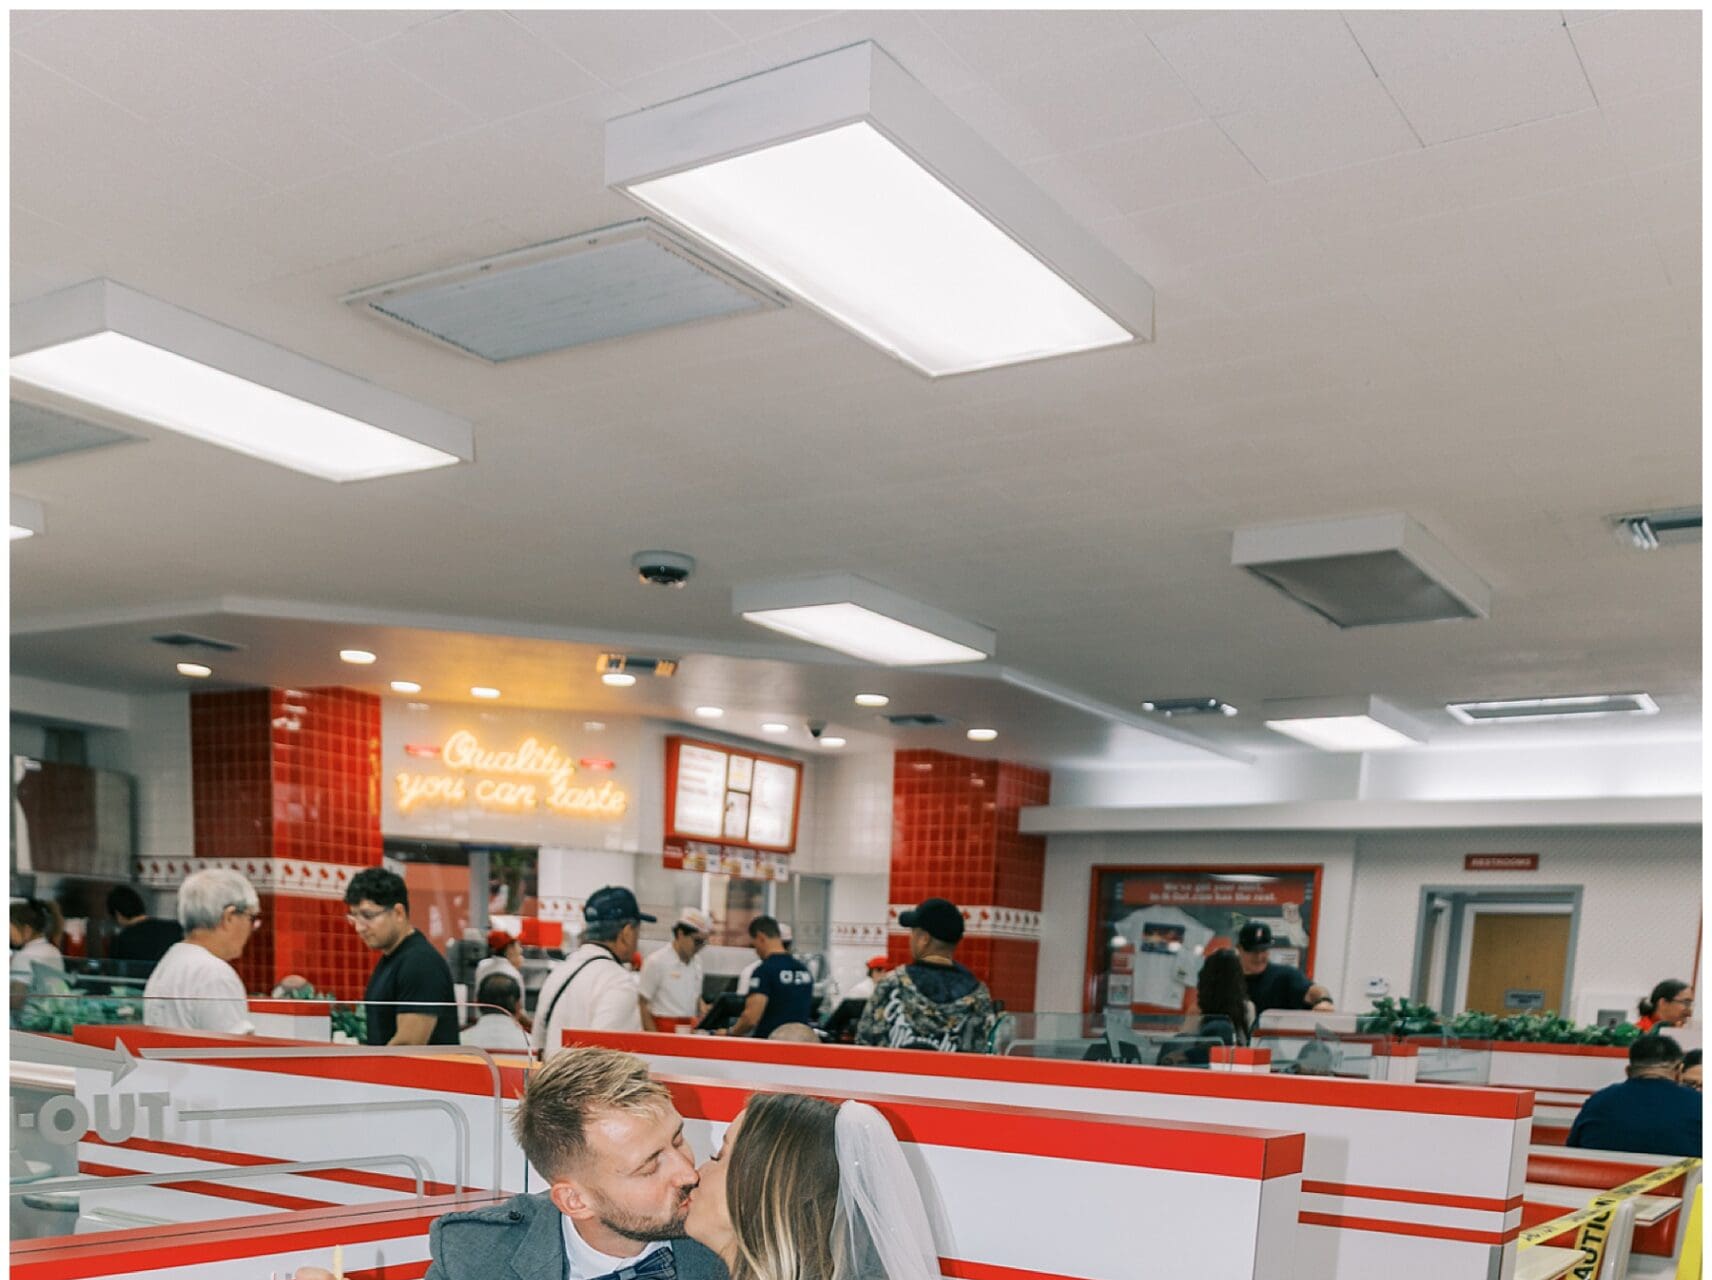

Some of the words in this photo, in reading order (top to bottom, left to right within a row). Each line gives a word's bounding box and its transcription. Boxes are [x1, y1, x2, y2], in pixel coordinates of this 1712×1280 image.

[443, 730, 576, 783] Quality
[396, 772, 466, 809] you
[475, 778, 537, 807] can
[546, 777, 627, 811] taste
[9, 1092, 171, 1147] -OUT
